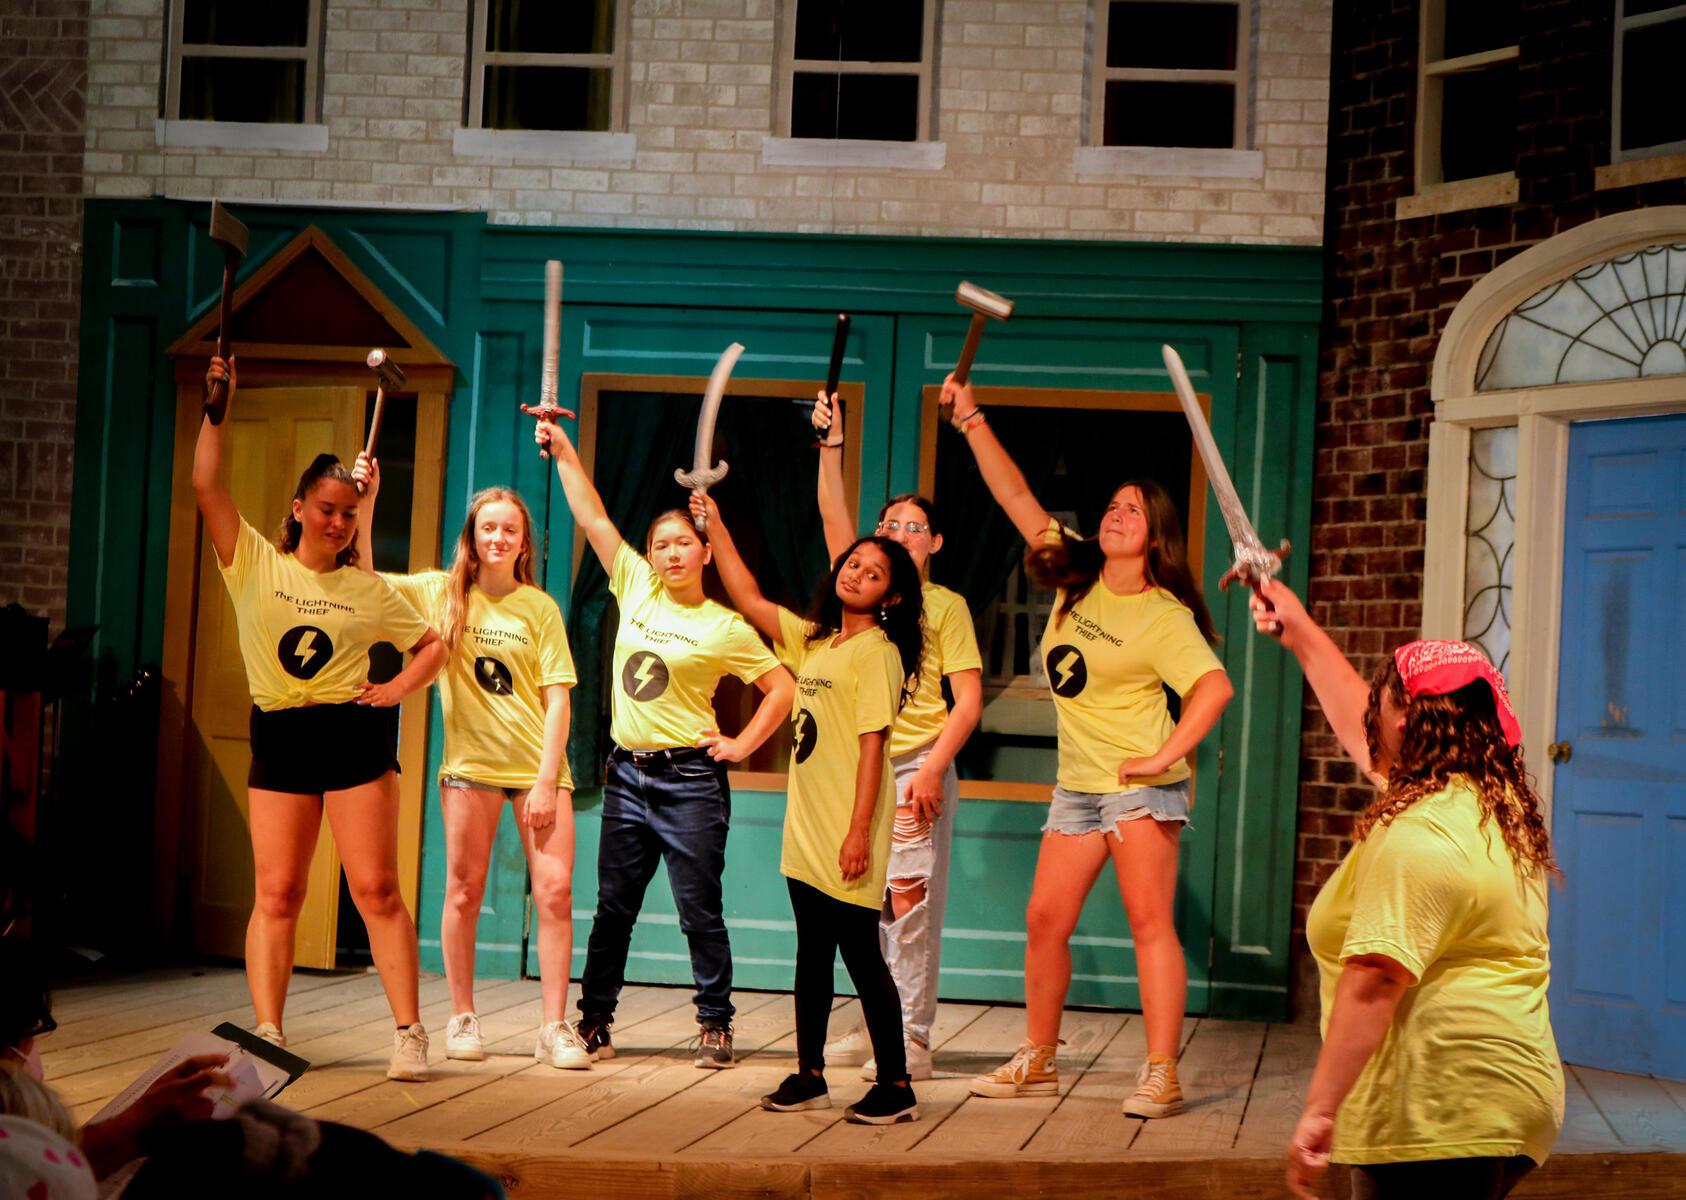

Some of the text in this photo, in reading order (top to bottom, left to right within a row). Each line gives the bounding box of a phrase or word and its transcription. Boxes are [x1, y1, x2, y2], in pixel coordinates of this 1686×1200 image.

[295, 598, 356, 614] LIGHTNING
[296, 607, 330, 615] THIEF
[472, 627, 528, 645] LIGHTNING
[645, 628, 699, 647] LIGHTNING
[1074, 625, 1098, 641] THIEF
[1078, 616, 1124, 647] LIGHTNING
[474, 636, 505, 646] THIEF
[645, 635, 672, 645] THIEF
